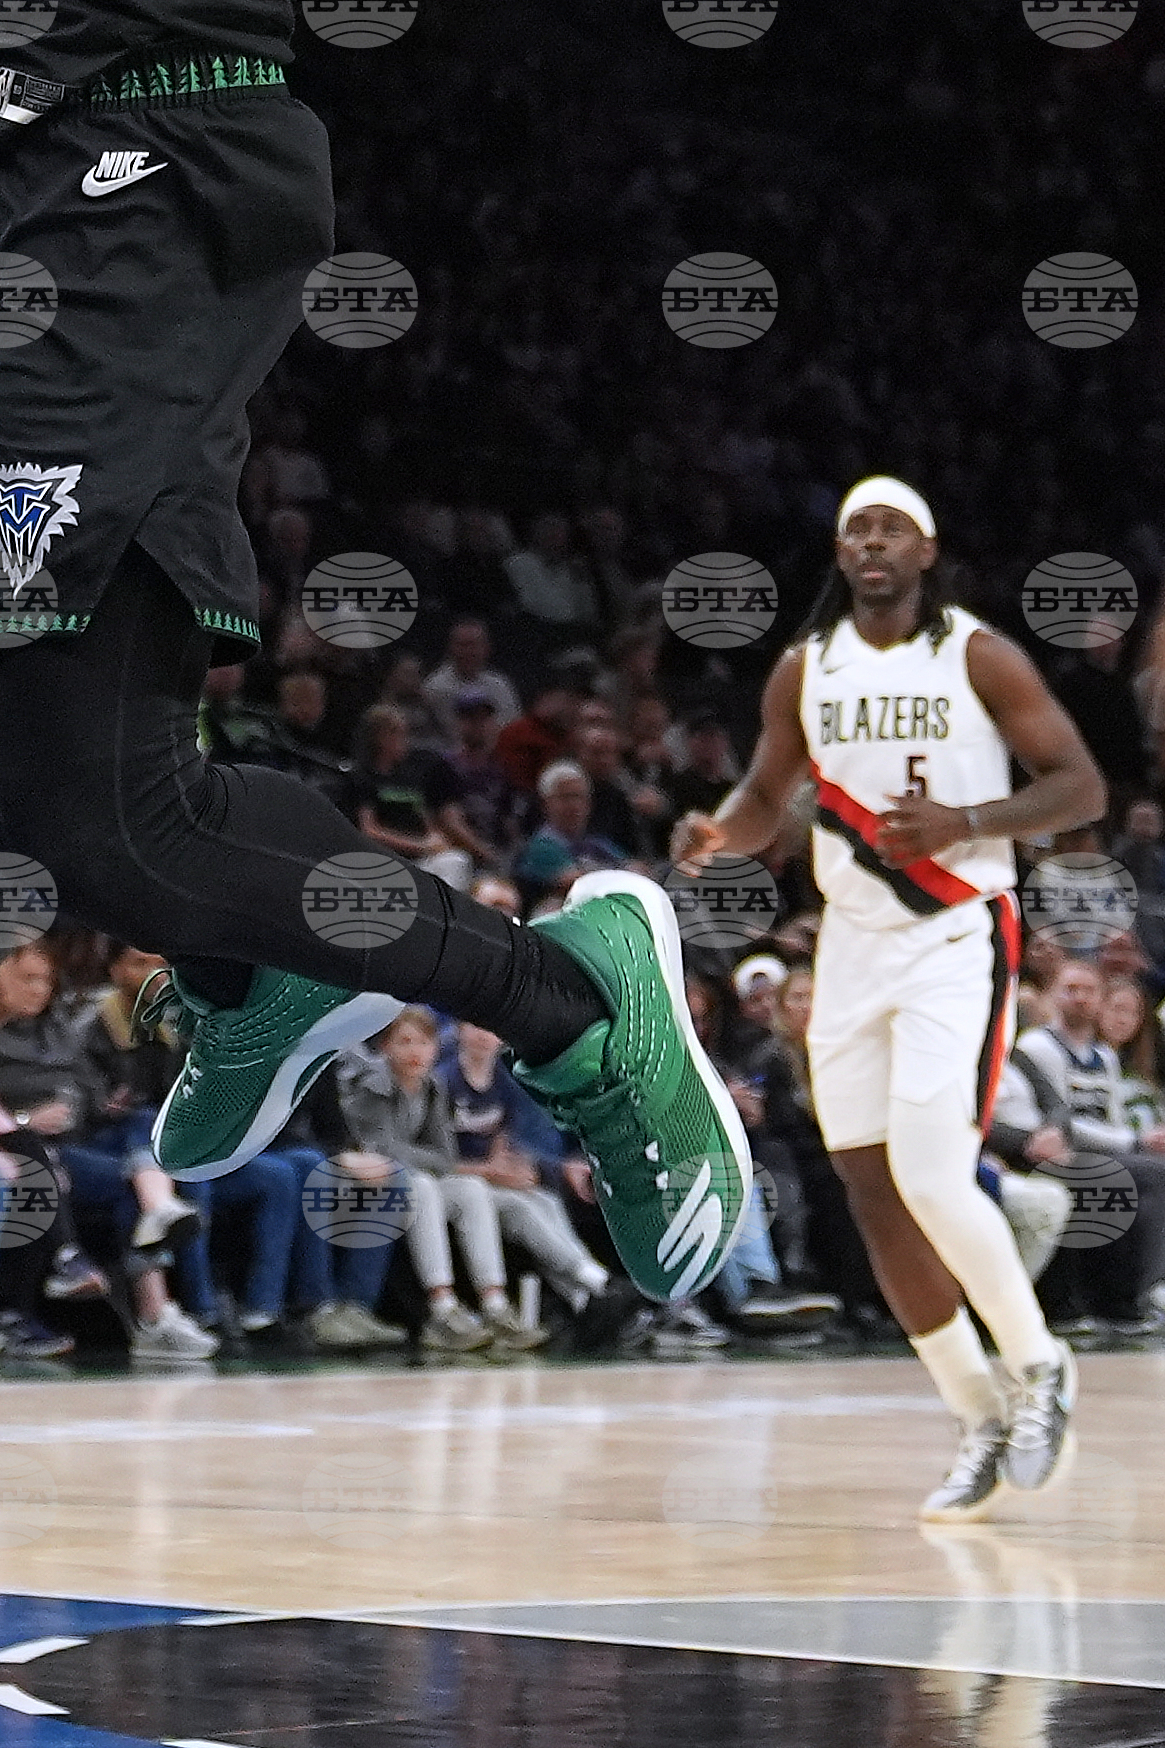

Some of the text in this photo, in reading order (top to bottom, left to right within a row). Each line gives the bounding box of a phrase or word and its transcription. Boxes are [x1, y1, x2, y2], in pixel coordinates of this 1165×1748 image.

[95, 151, 150, 178] NIKE
[818, 695, 951, 745] BLAZERS
[905, 754, 928, 798] 5
